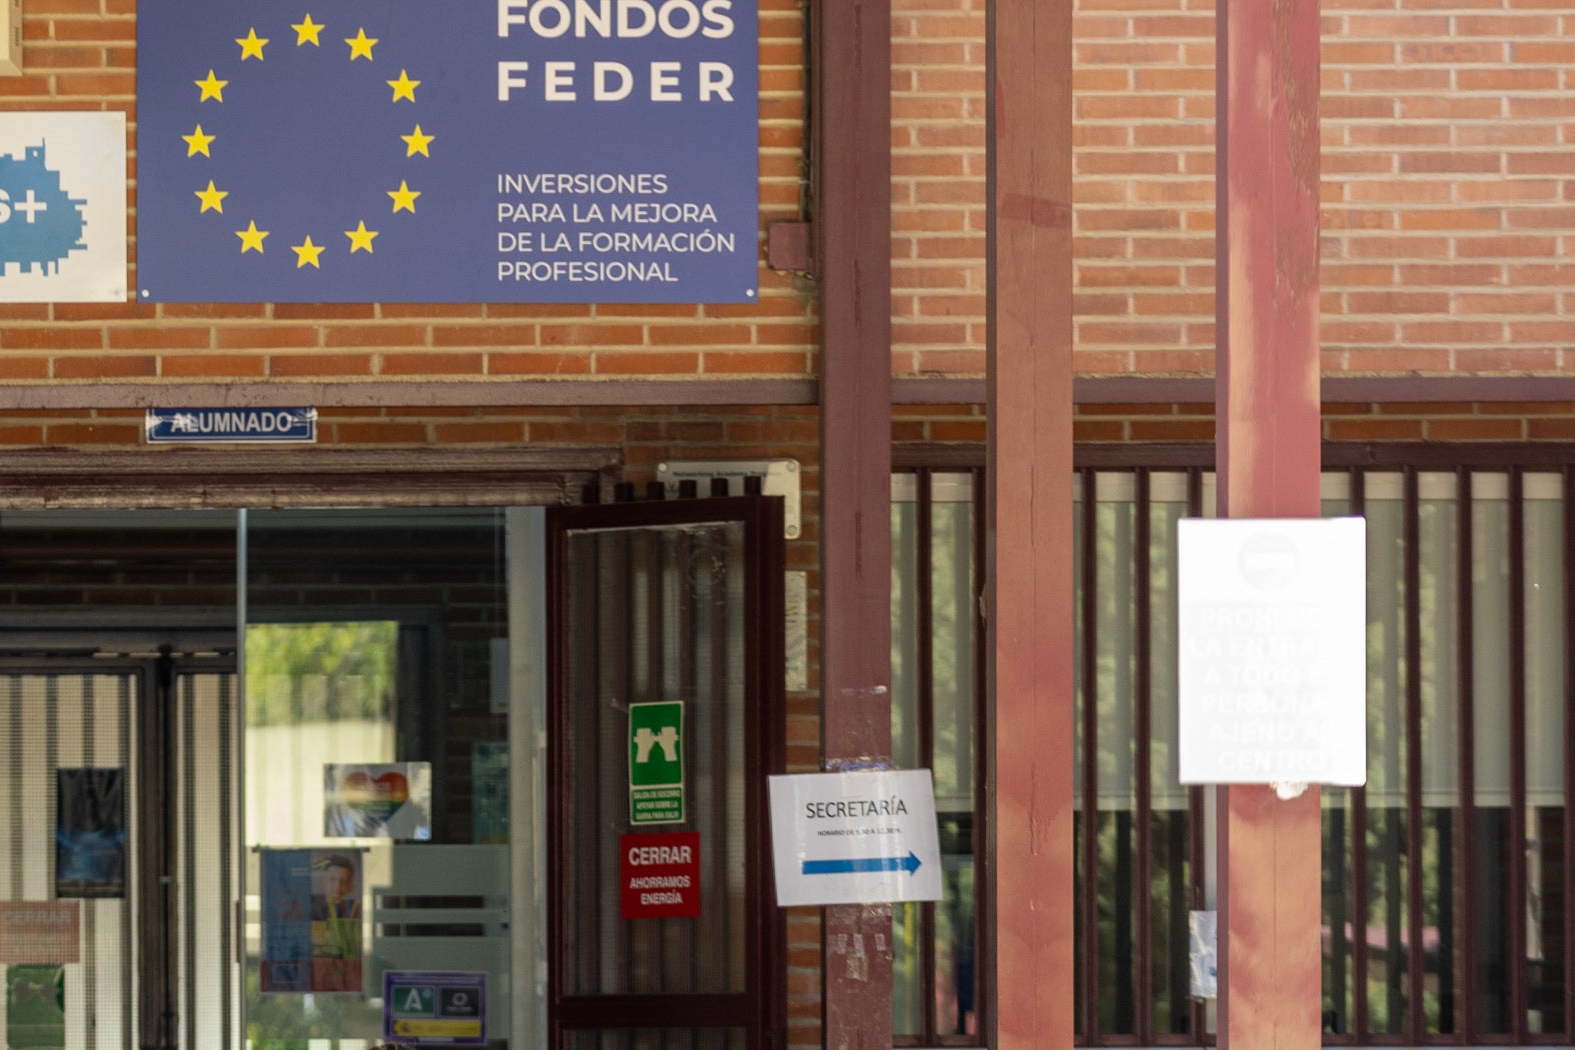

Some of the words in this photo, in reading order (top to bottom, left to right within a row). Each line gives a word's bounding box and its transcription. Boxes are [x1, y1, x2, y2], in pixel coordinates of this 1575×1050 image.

[497, 0, 735, 38] FONDOS
[497, 61, 735, 102] FEDER
[497, 174, 668, 194] INVERSIONES
[497, 203, 567, 223] PARA
[572, 203, 605, 223] LA
[610, 203, 718, 223] MEJORA
[497, 232, 533, 252] DE
[540, 232, 572, 252] LA
[578, 229, 735, 252] FORMACIÓN
[497, 261, 679, 282] PROFESIONAL
[171, 411, 292, 433] ALUMNADO
[806, 795, 908, 819] SECRETARÍA
[629, 845, 692, 866] CERRAR
[630, 875, 691, 889] AHORRAMOS
[640, 889, 683, 905] ENERGÍA
